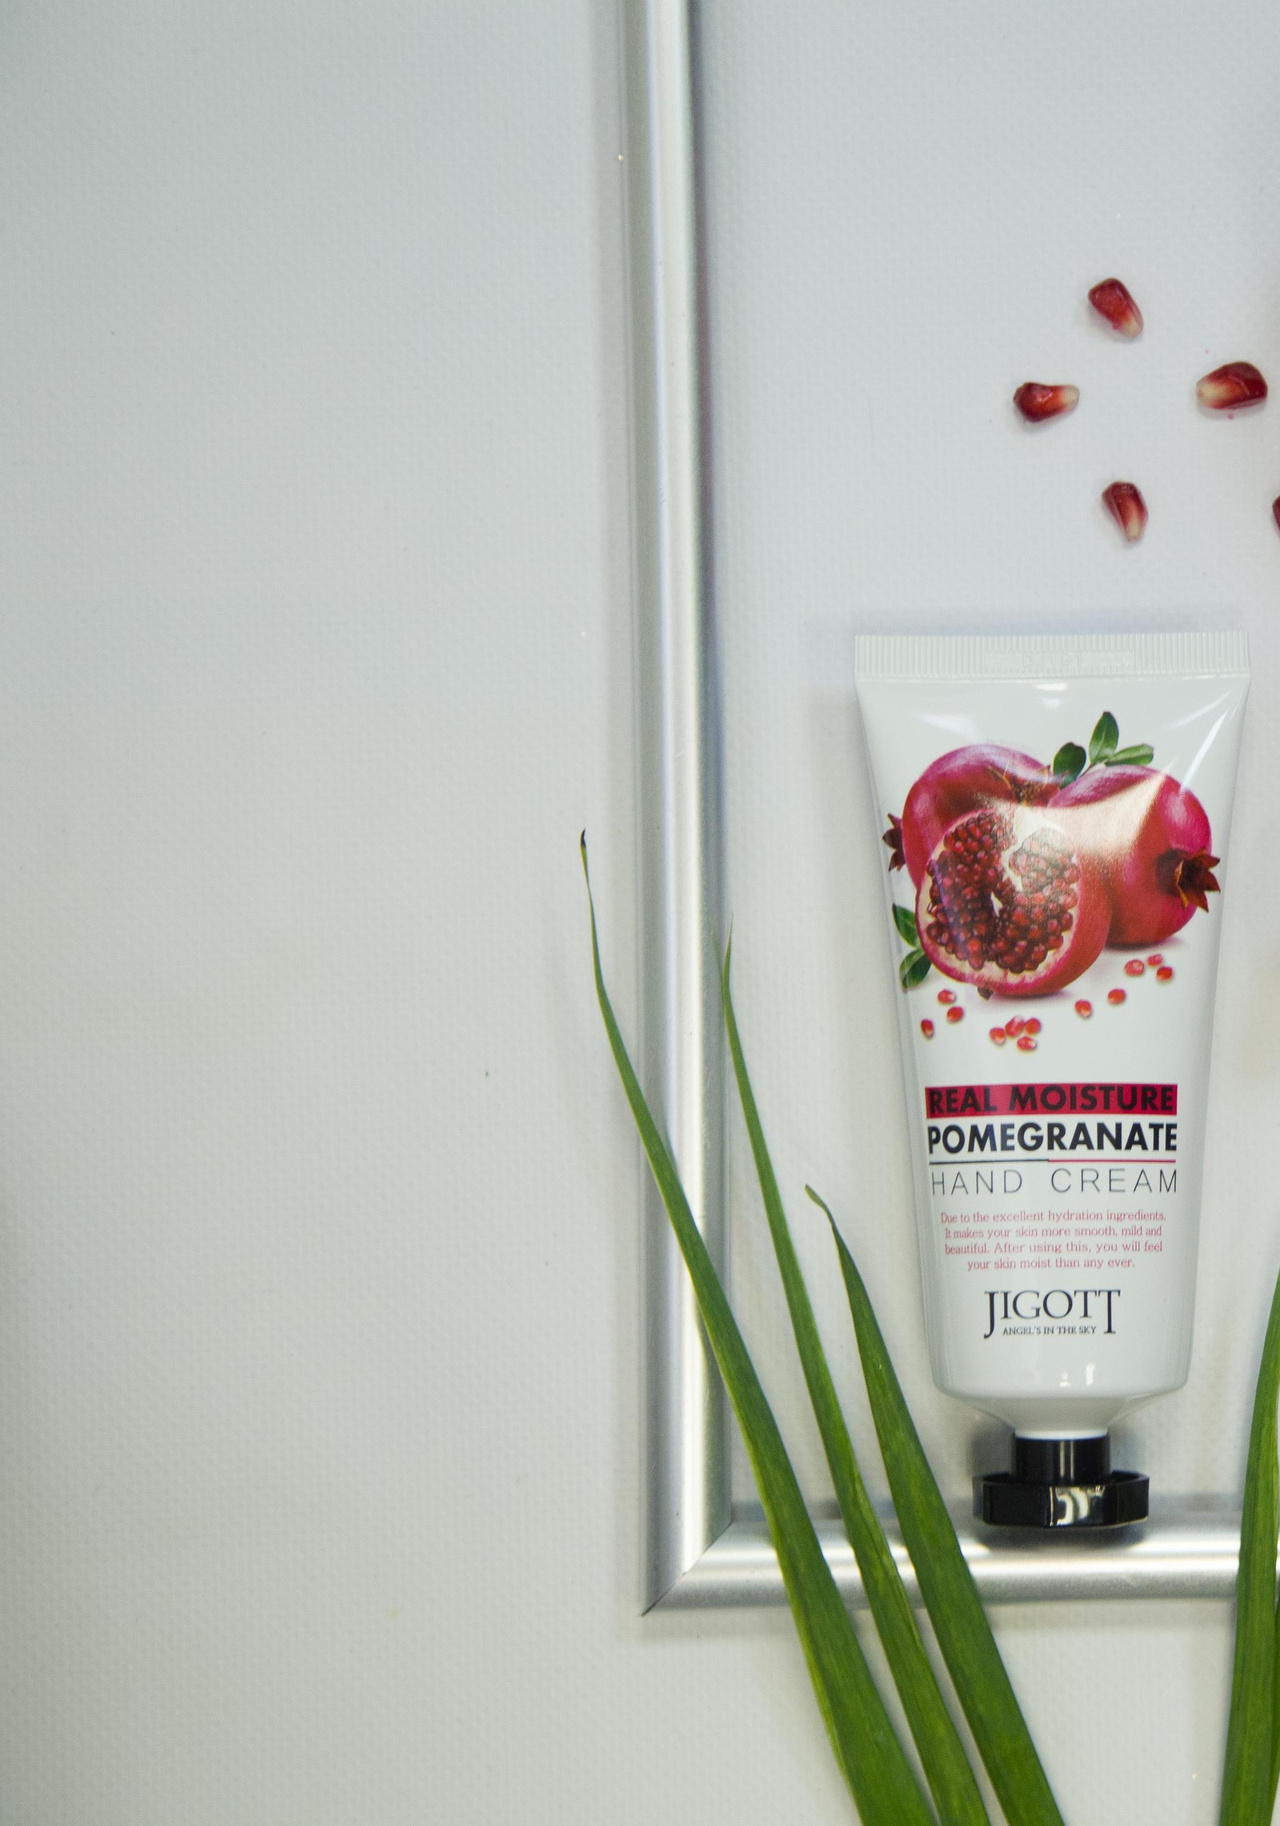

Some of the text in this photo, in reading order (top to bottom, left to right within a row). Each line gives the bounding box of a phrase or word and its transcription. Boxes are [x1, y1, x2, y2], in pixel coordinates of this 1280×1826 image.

[929, 1085, 1173, 1114] REAL MOISTURE
[928, 1122, 1177, 1154] POMEGRANATE
[932, 1168, 1177, 1196] HAND CREAM
[941, 1212, 957, 1224] Due
[960, 1214, 970, 1223] to
[973, 1212, 989, 1222] the
[992, 1211, 1044, 1221] excellent
[1048, 1210, 1102, 1222] hydration
[945, 1228, 951, 1239] It
[954, 1228, 984, 1238] makes
[987, 1229, 1012, 1240] your
[1016, 1227, 1038, 1237] skin
[1041, 1228, 1071, 1236] more
[1121, 1226, 1142, 1236] mild
[1145, 1226, 1162, 1236] and
[945, 1242, 989, 1255] beautiful.
[994, 1242, 1025, 1253] After
[1030, 1242, 1062, 1253] using
[1096, 1243, 1118, 1253] you
[1122, 1241, 1140, 1251] will
[1144, 1241, 1163, 1252] feel
[968, 1260, 990, 1271] your
[994, 1258, 1016, 1269] skin
[1020, 1258, 1051, 1269] moist
[1055, 1257, 1080, 1268] than
[1084, 1259, 1104, 1269] any
[984, 1289, 1121, 1339] JIGOTT
[1044, 1326, 1054, 1334] IN
[1057, 1326, 1076, 1334] THE
[1079, 1326, 1096, 1334] SKY
